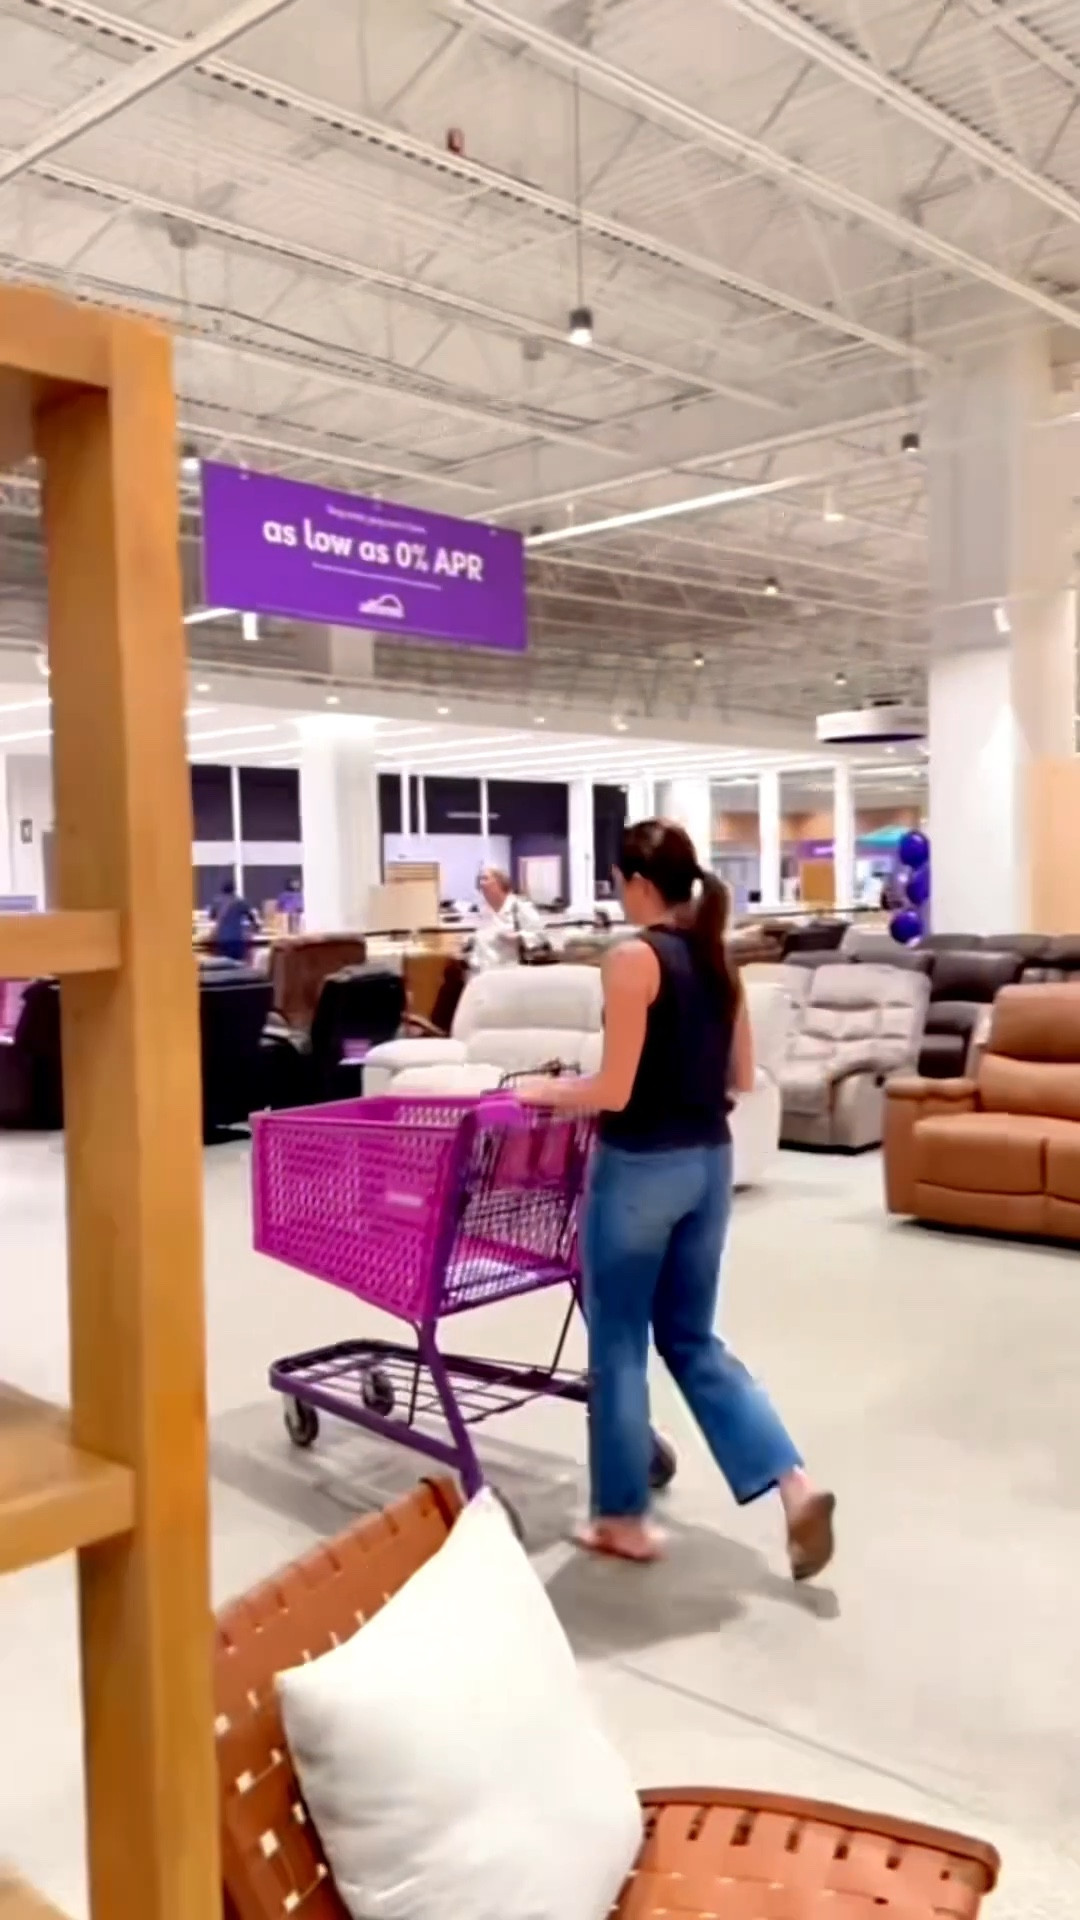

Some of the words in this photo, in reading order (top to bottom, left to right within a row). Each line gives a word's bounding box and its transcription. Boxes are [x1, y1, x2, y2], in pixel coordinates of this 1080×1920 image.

[263, 519, 297, 547] as
[303, 518, 352, 557] low
[359, 540, 389, 565] as
[395, 541, 429, 573] 0%
[433, 546, 485, 582] APR
